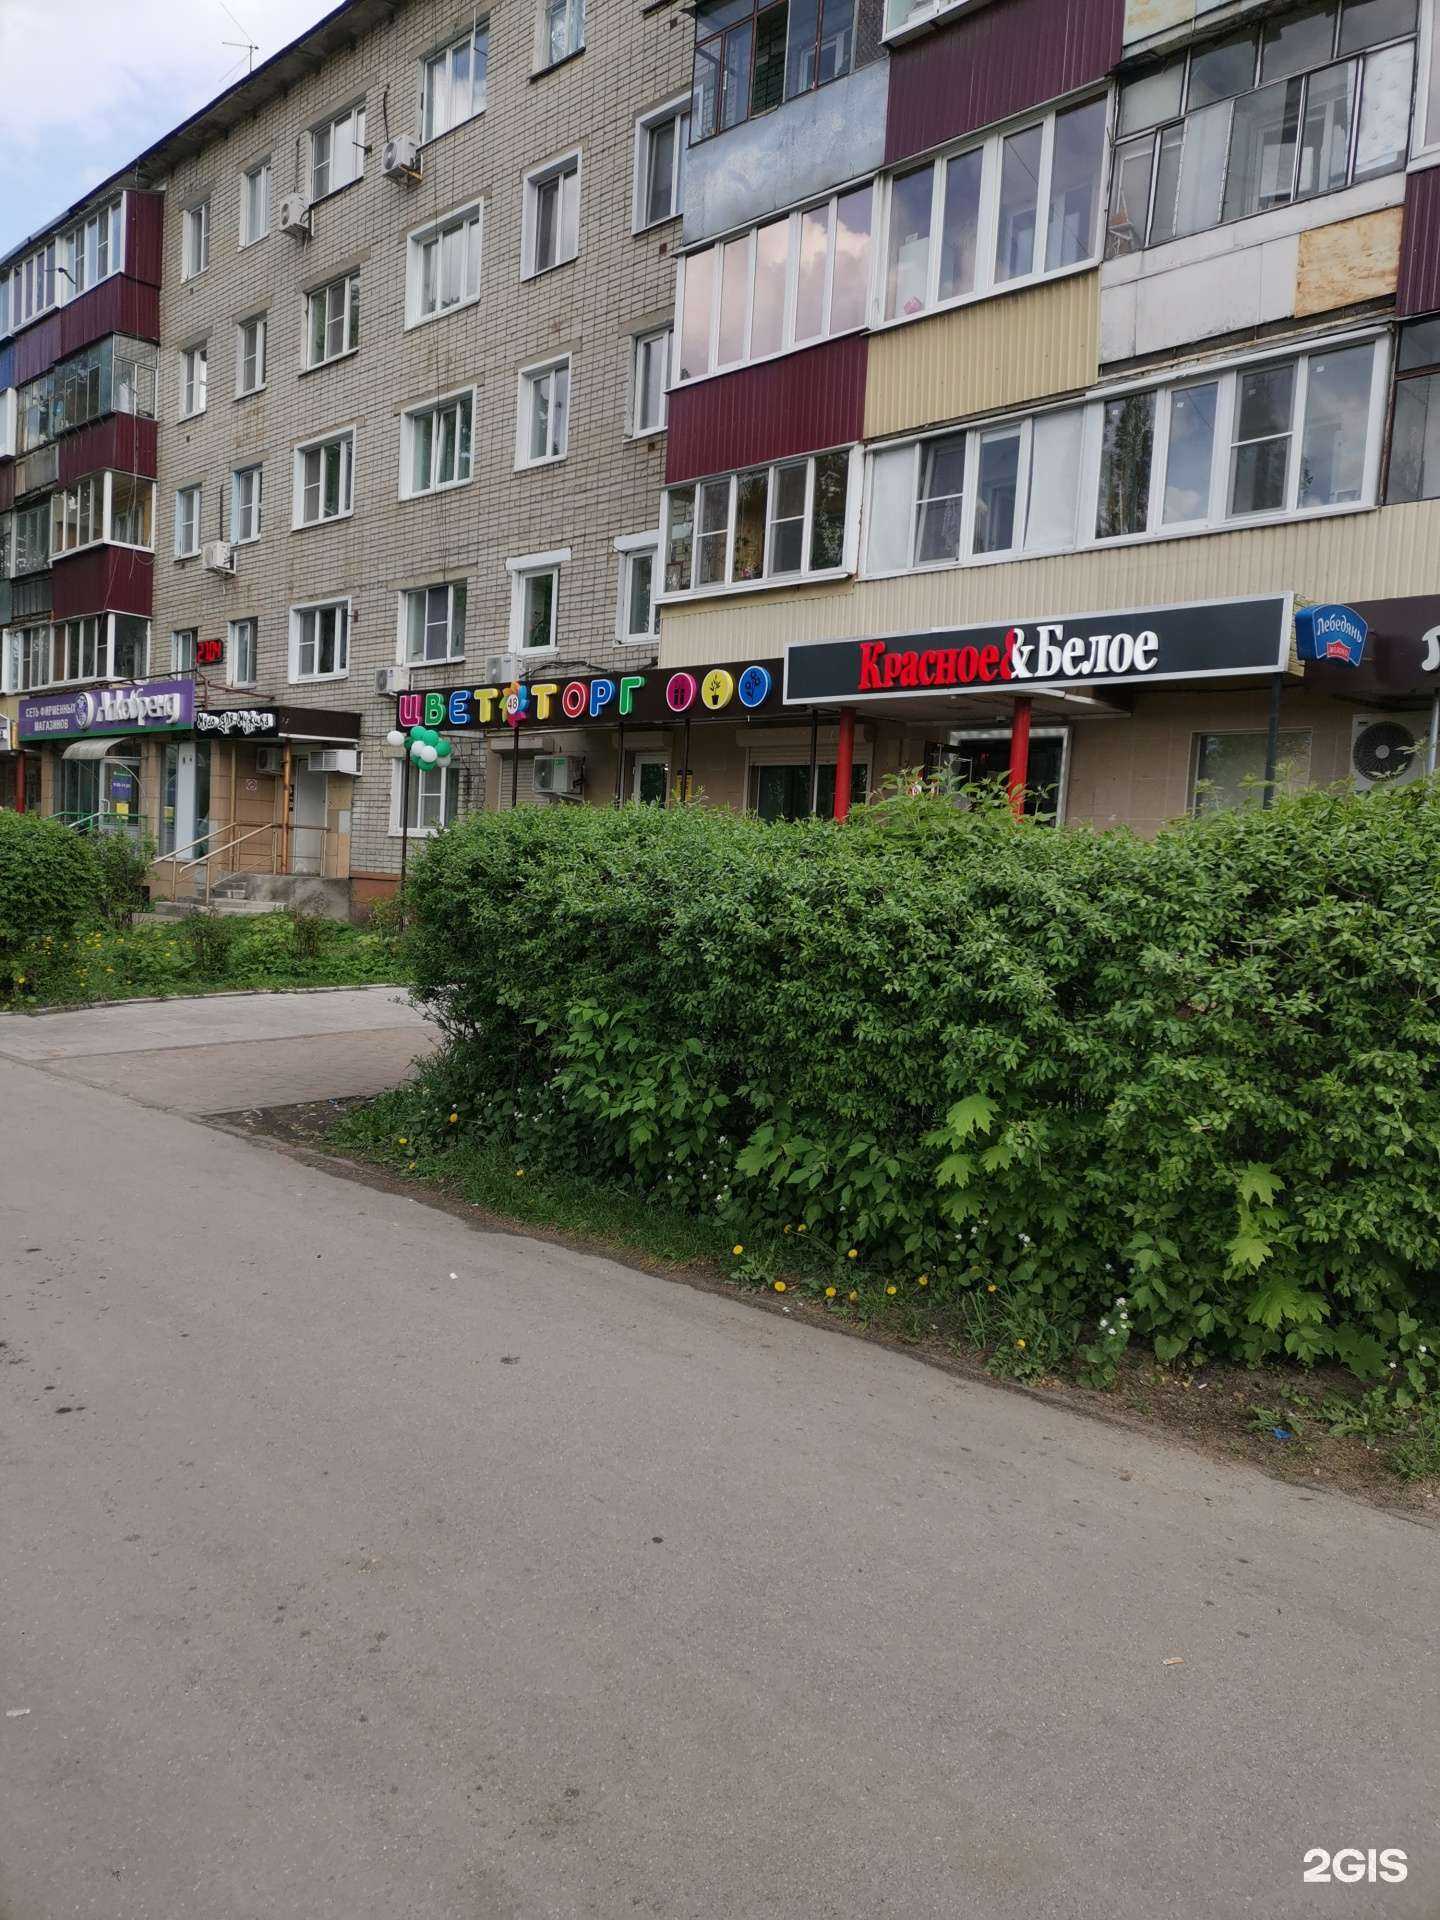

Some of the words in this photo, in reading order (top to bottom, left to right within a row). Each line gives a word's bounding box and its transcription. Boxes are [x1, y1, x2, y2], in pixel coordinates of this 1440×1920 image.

[1317, 614, 1363, 643] Лебедянь
[25, 707, 39, 718] СЕТЬ
[40, 702, 77, 717] ФИРМЕННЫХ
[507, 697, 518, 709] 48
[34, 719, 69, 731] МАГАЗИНОВ
